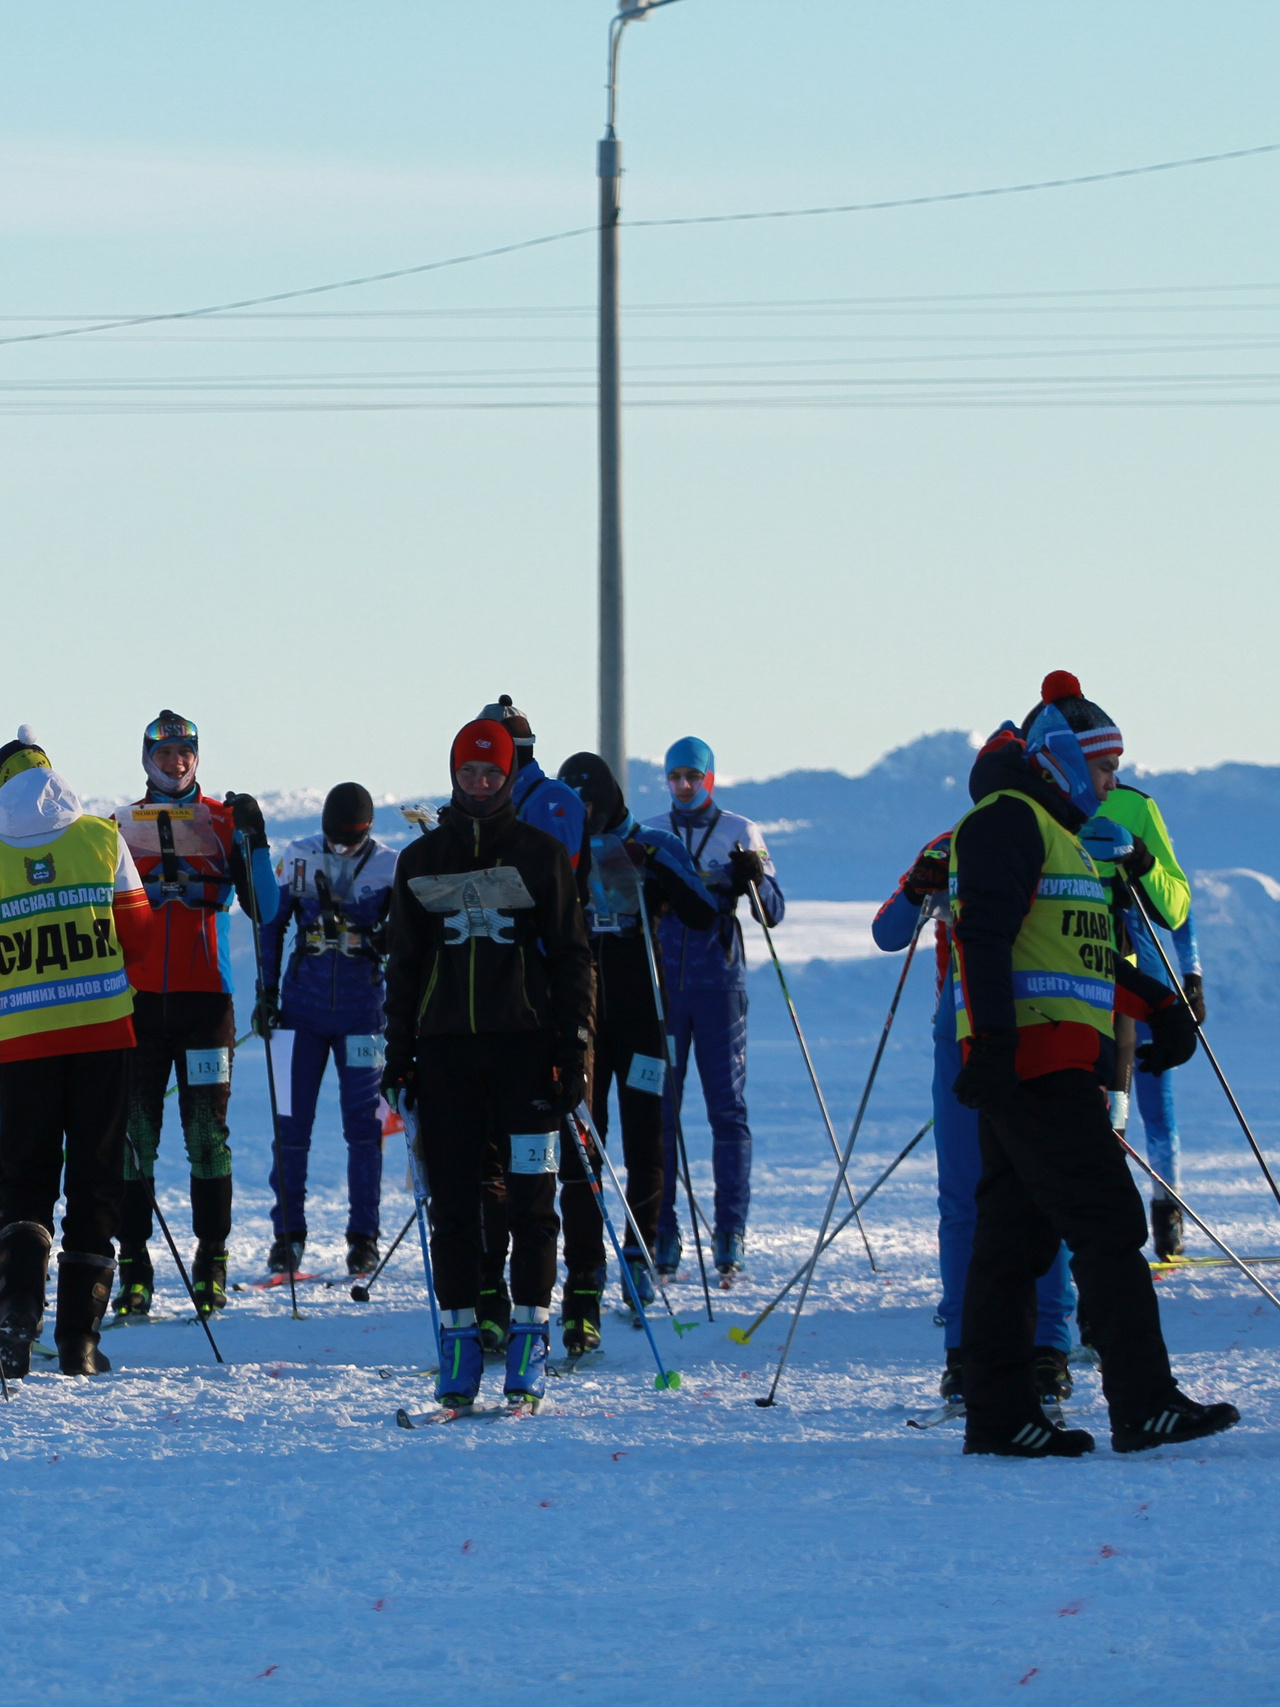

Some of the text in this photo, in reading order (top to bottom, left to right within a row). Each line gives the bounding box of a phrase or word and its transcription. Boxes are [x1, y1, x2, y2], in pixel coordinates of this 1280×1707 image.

[10, 986, 56, 1008] ЗИМНИХ
[57, 980, 101, 999] ВИДОВ
[198, 1061, 220, 1073] 13.1
[528, 1148, 547, 1161] 2.1
